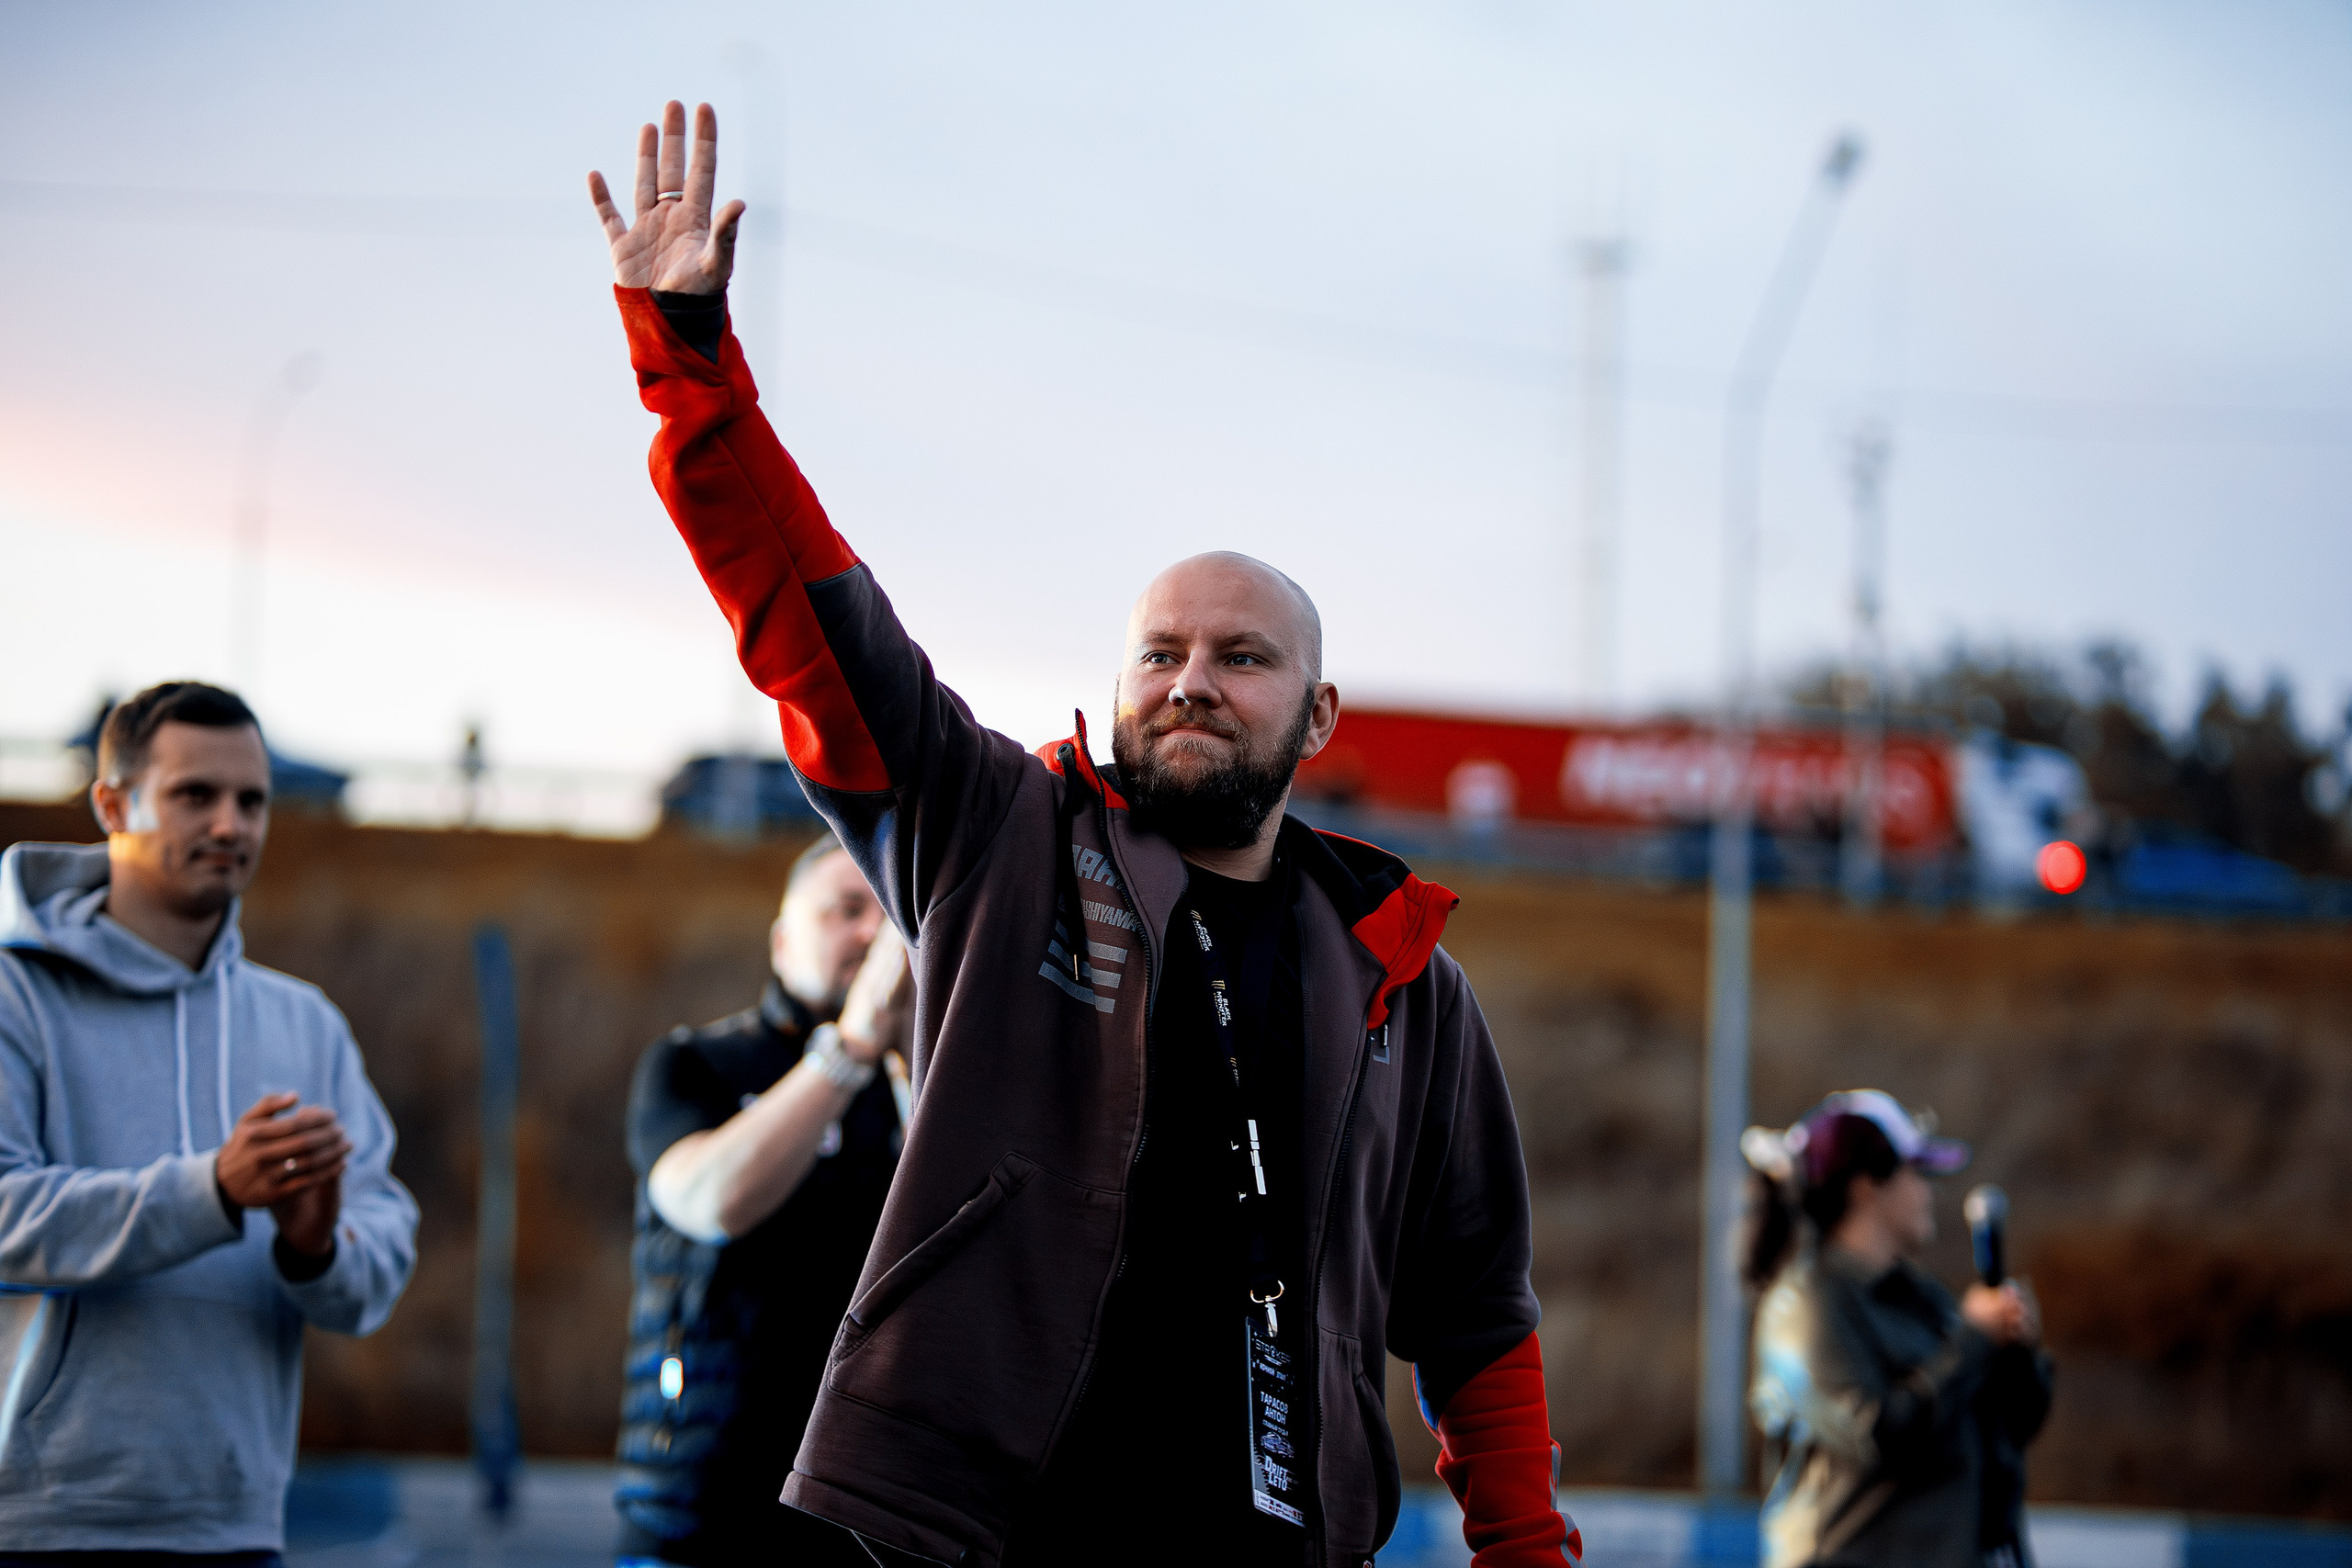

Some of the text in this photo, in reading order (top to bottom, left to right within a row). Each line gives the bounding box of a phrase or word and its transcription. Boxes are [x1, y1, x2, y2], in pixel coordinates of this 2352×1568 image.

[1261, 1391, 1289, 1414] ТАРАСОВ
[1264, 1405, 1286, 1425] АНТОН
[1264, 1455, 1287, 1477] DRIFT
